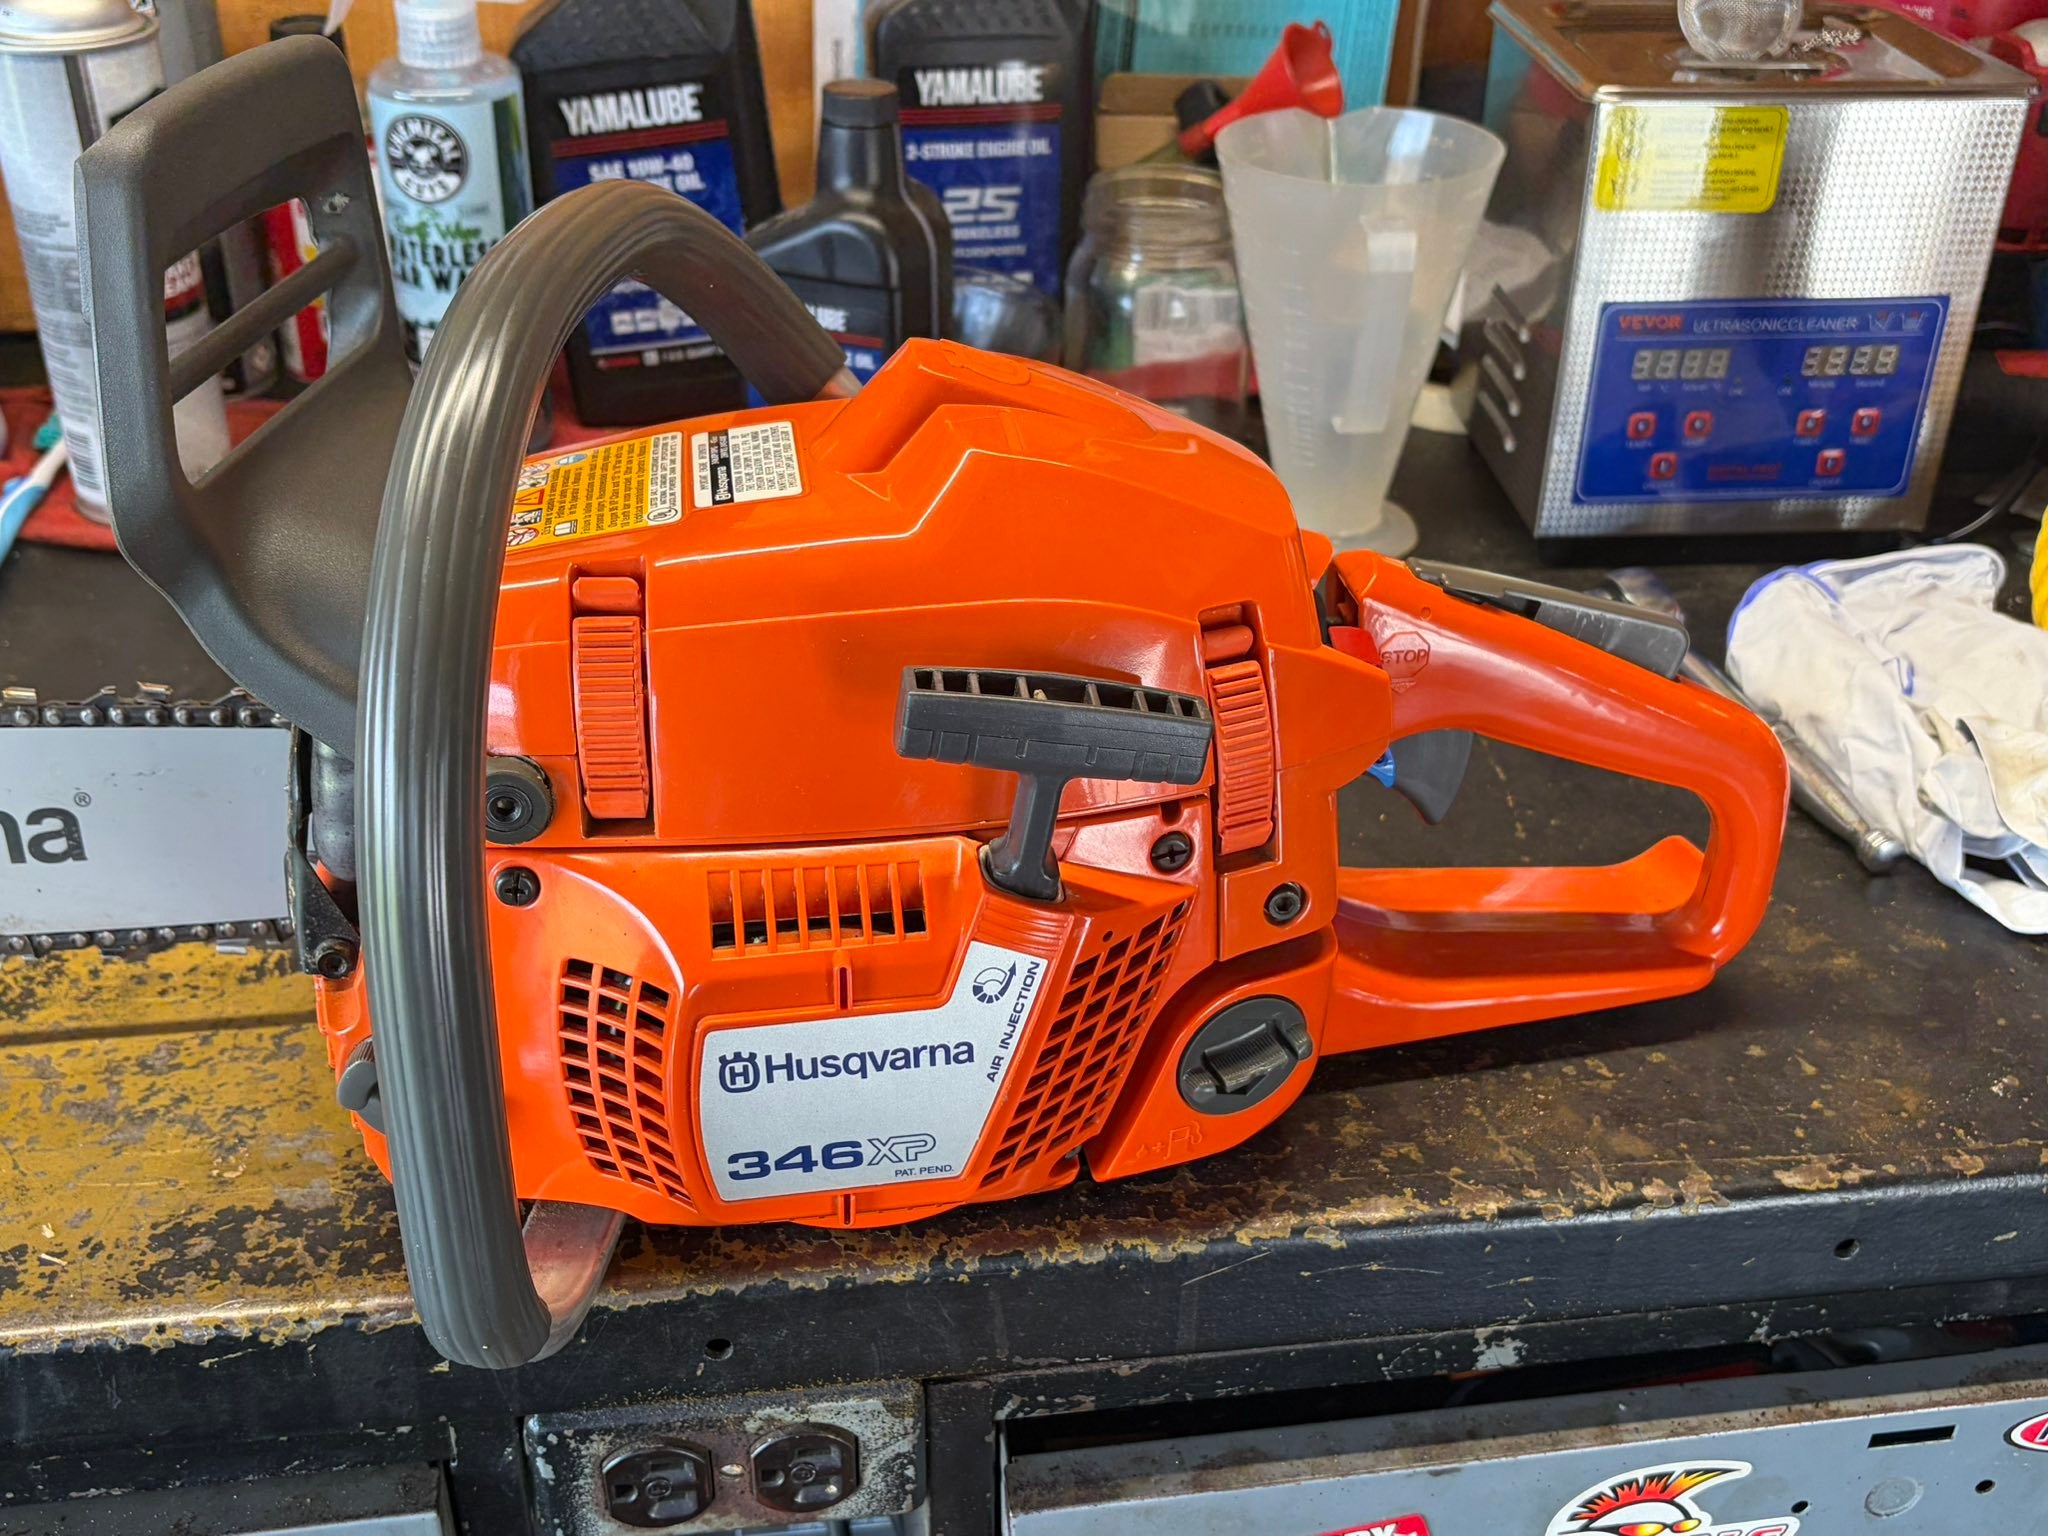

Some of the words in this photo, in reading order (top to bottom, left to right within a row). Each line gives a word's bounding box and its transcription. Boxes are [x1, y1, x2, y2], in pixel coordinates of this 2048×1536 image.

[914, 67, 1044, 106] YAMALUBE
[558, 83, 703, 136] YAMALUBE
[388, 118, 461, 162] CHEMICAL
[977, 139, 1026, 158] ENGINE
[1029, 138, 1052, 156] OIL
[588, 160, 625, 182] SAE
[628, 152, 694, 176] 10W-40
[675, 171, 706, 192] OIL
[941, 186, 1023, 224] 25
[1618, 314, 1685, 331] VEVOR
[1381, 648, 1428, 664] STOP
[986, 1054, 1006, 1083] AIR
[999, 960, 1041, 1050] INJECTION
[764, 1040, 975, 1084] Husqvarna
[894, 1166, 917, 1178] PAT.
[919, 1164, 954, 1175] PEND.
